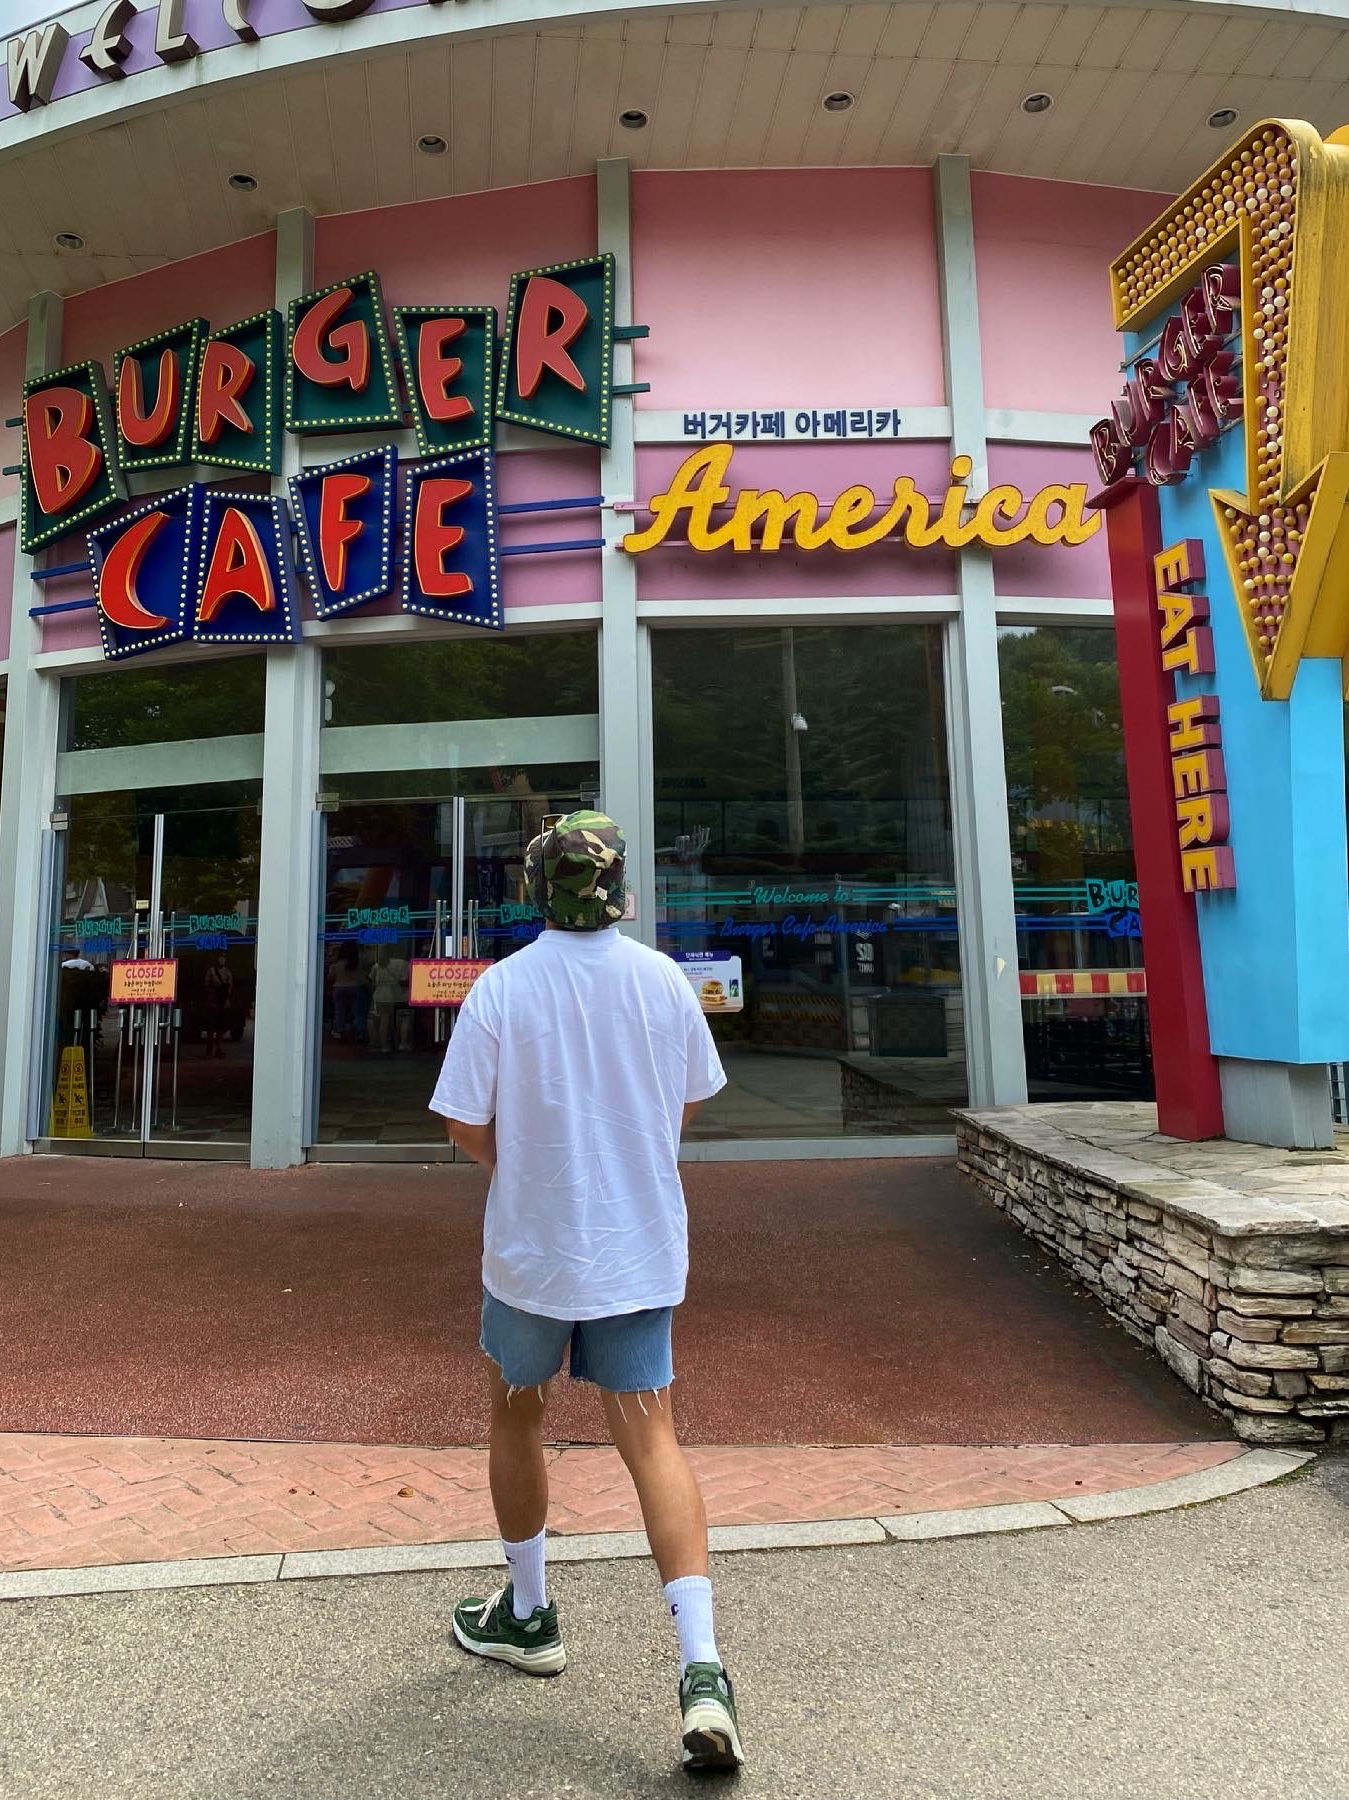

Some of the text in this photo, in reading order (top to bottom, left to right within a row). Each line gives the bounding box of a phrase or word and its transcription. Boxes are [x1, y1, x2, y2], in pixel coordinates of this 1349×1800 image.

[25, 276, 589, 515] BURGER
[684, 409, 901, 439] 버거카페 아메리카
[623, 442, 1103, 553] America
[99, 474, 475, 630] CAFE
[1153, 540, 1230, 892] EAT HERE
[754, 885, 850, 904] Welcome to
[1088, 882, 1139, 909] BUR
[190, 913, 240, 933] BURGER
[349, 905, 409, 927] BURGER
[501, 903, 546, 923] BUR
[1108, 910, 1140, 934] CA
[75, 918, 121, 937] BURGER
[125, 967, 165, 979] CLOSED
[428, 968, 479, 980] CLOSED
